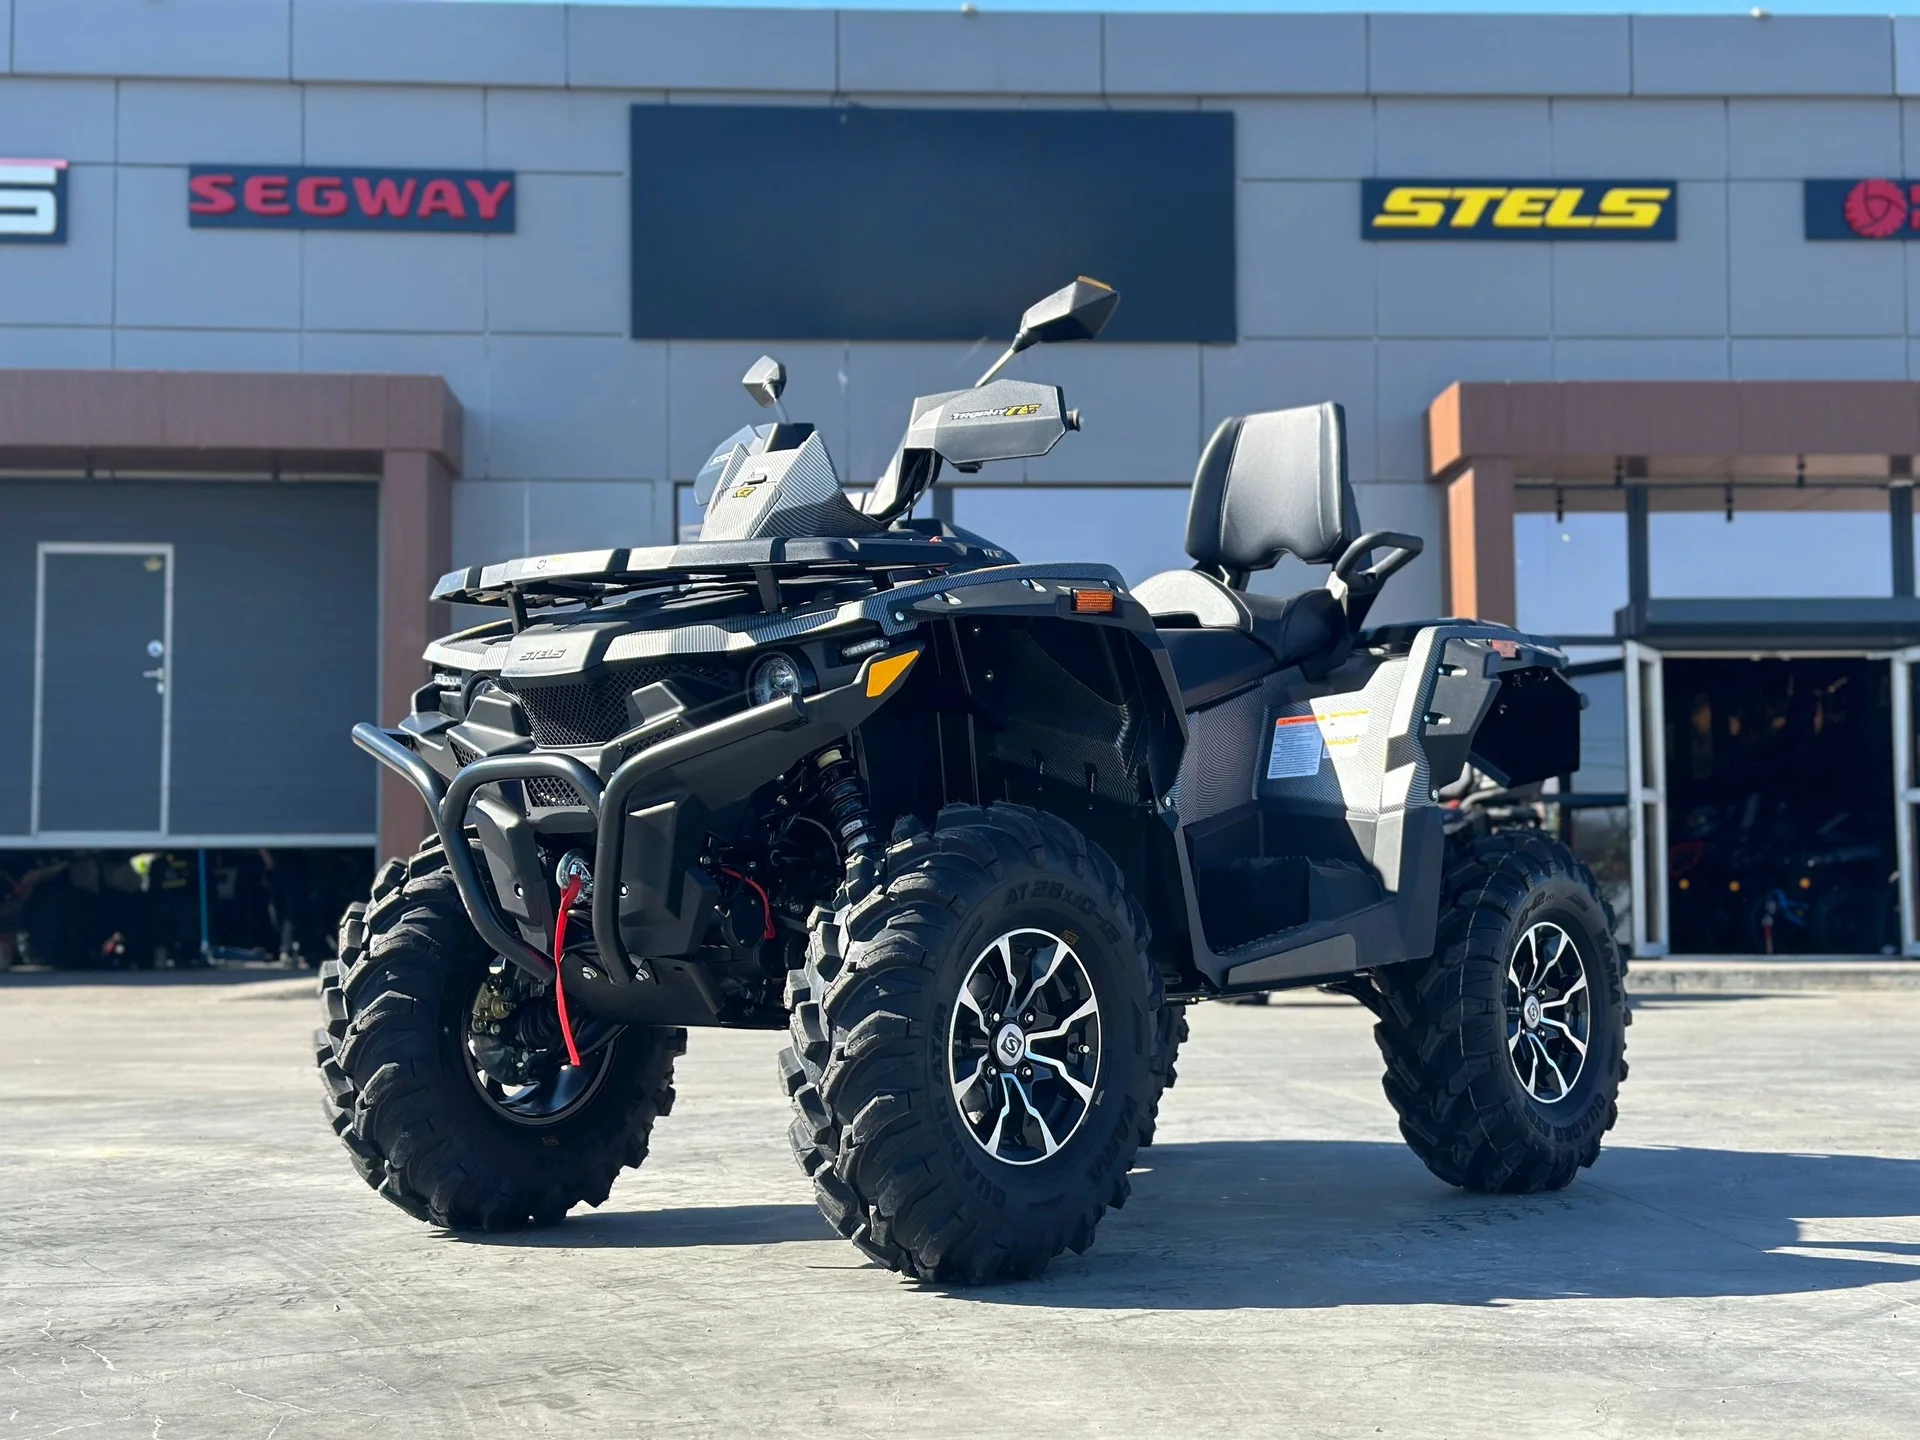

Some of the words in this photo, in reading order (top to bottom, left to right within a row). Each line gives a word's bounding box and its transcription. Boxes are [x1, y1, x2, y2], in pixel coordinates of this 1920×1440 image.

[189, 174, 512, 220] SEGWAY
[1371, 187, 1671, 229] STELS
[519, 648, 567, 661] STELS
